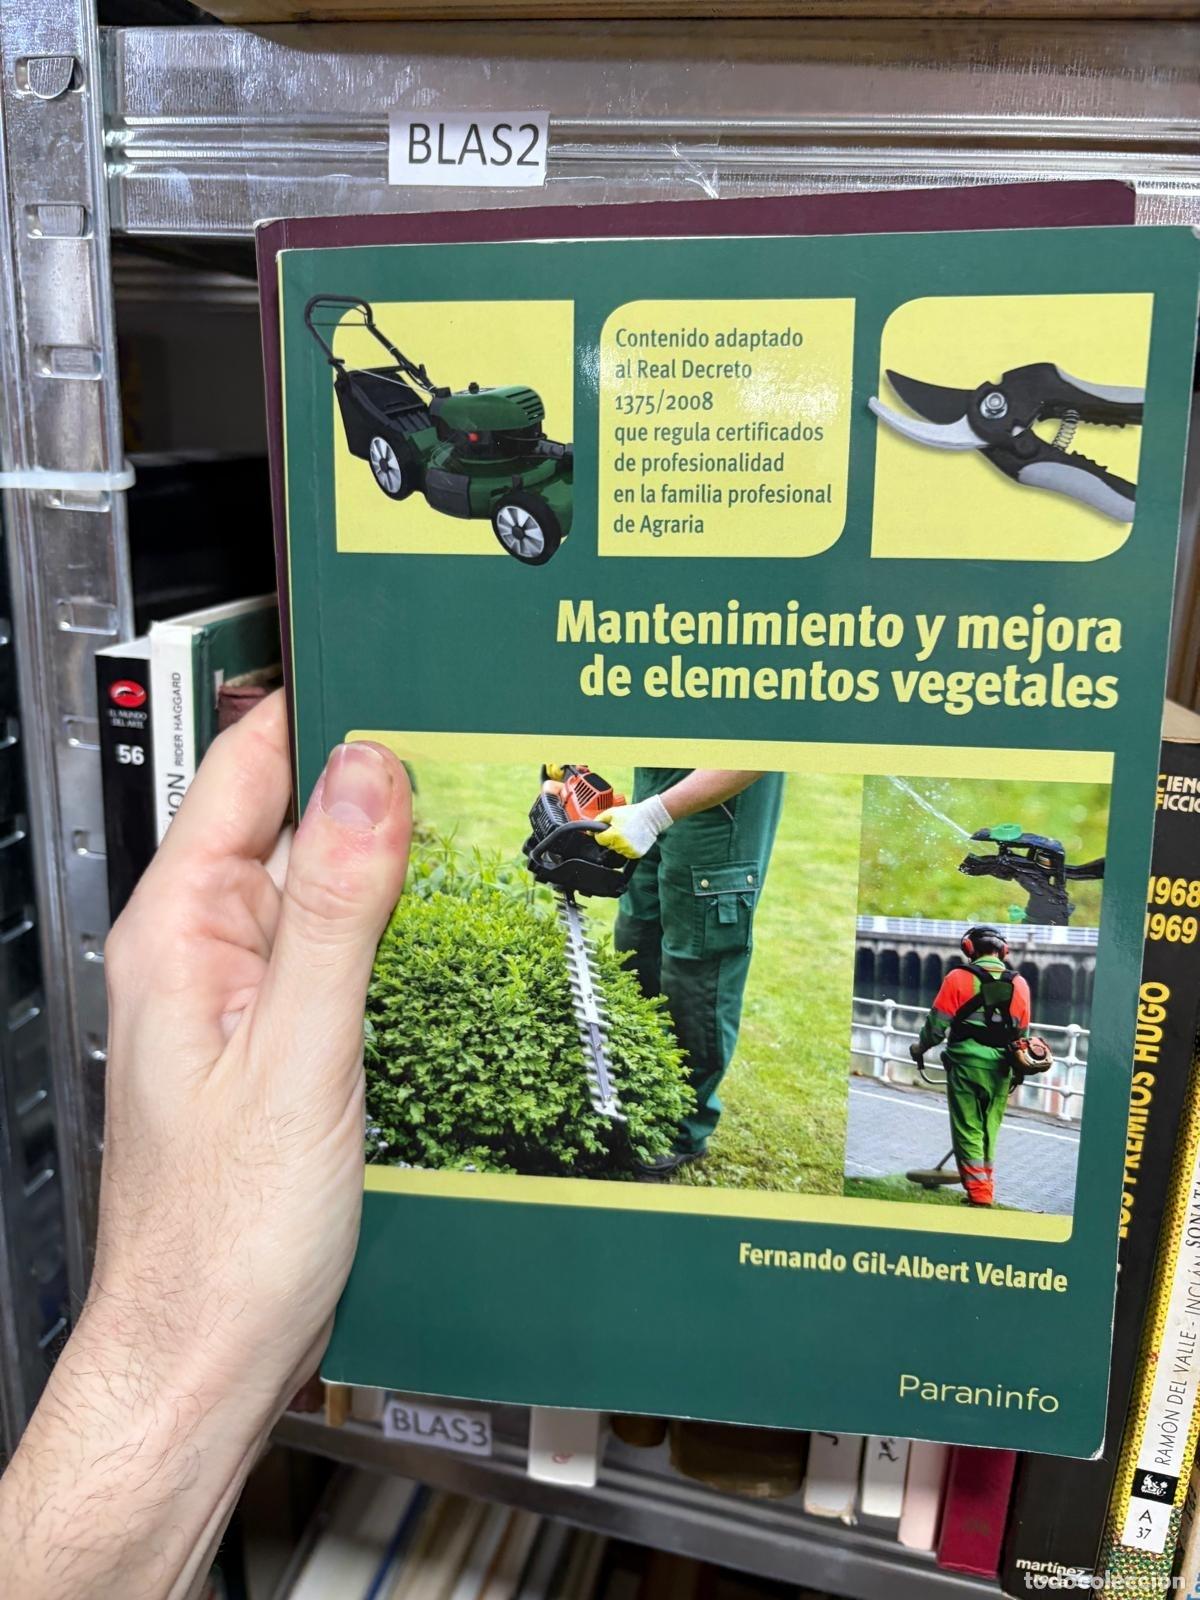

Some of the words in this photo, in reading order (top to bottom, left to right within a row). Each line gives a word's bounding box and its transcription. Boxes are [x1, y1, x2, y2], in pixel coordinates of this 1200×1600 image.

[408, 123, 540, 166] BLAS2
[615, 328, 710, 348] Contenido
[714, 327, 804, 351] adaptado
[615, 358, 632, 378] al
[637, 359, 676, 378] Real
[682, 359, 752, 379] Decreto
[615, 388, 714, 415] 1375/2008
[614, 426, 648, 446] que
[653, 422, 711, 446] regula
[716, 421, 824, 441] certificados
[614, 452, 636, 472] de
[641, 452, 785, 476] profesionalidad
[613, 487, 635, 503] en
[641, 484, 656, 503] la
[661, 484, 723, 503] familia
[728, 484, 832, 508] profesional
[613, 514, 635, 533] de
[639, 514, 705, 538] Agraria
[556, 599, 905, 648] Mantenimiento
[915, 614, 947, 662] y
[957, 603, 1122, 664] mejora
[579, 653, 632, 697] de
[643, 654, 880, 702] elementos
[890, 662, 1120, 716] vegetales
[171, 672, 184, 731] HAGGARD
[116, 743, 145, 766] 56
[173, 735, 185, 766] RIDER
[167, 773, 185, 818] ON
[1134, 981, 1171, 1064] HUGO
[738, 1242, 847, 1272] Fernando
[852, 1251, 970, 1284] Gil-Albert
[975, 1261, 1069, 1293] Velarde
[1172, 1330, 1197, 1374] VALLE
[899, 1373, 1060, 1414] Paraninfo
[1166, 1377, 1188, 1406] DEL
[391, 1407, 490, 1448] BLAS3
[1154, 1409, 1179, 1467] RAMÓN
[1138, 1509, 1153, 1524] A
[1136, 1526, 1152, 1540] 37
